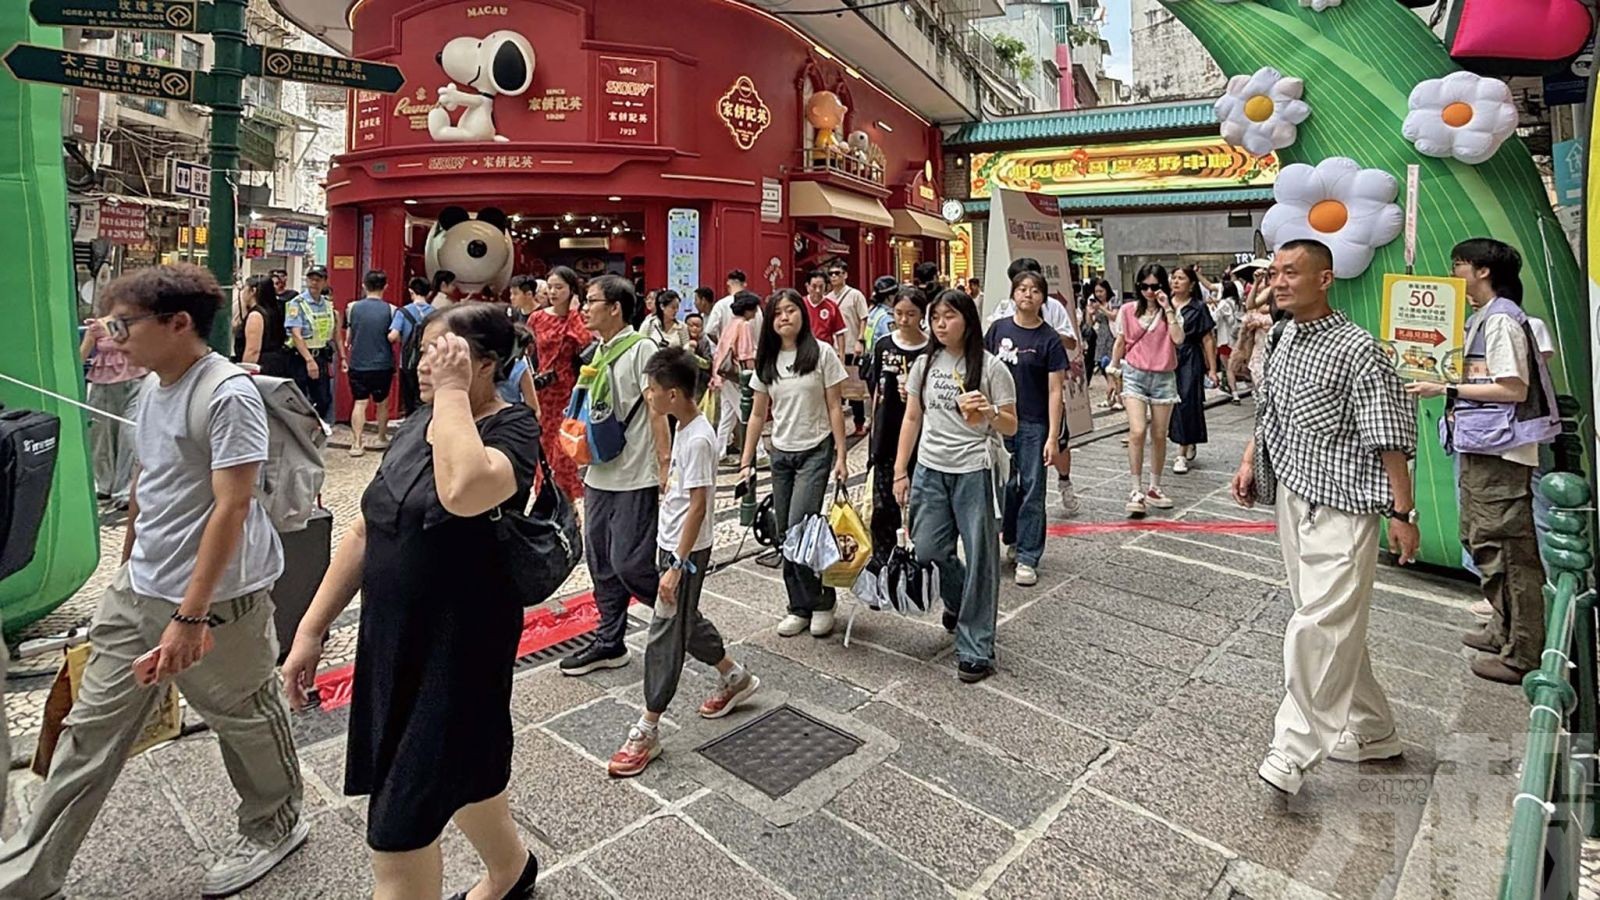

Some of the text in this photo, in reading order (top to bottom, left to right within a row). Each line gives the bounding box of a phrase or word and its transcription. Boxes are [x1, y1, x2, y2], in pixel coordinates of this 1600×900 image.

[62, 9, 94, 18] IGREJA
[96, 10, 109, 18] DE
[120, 12, 165, 21] DOMINGOS
[466, 5, 508, 17] MACAU
[61, 53, 161, 80] 大三巴牌坊
[292, 65, 320, 74] LARGO
[322, 67, 333, 76] DE
[106, 75, 119, 83] DE
[606, 80, 655, 97] SNOOPY
[194, 182, 208, 193] WC
[1234, 252, 1256, 264] TRY
[1408, 290, 1435, 308] 50
